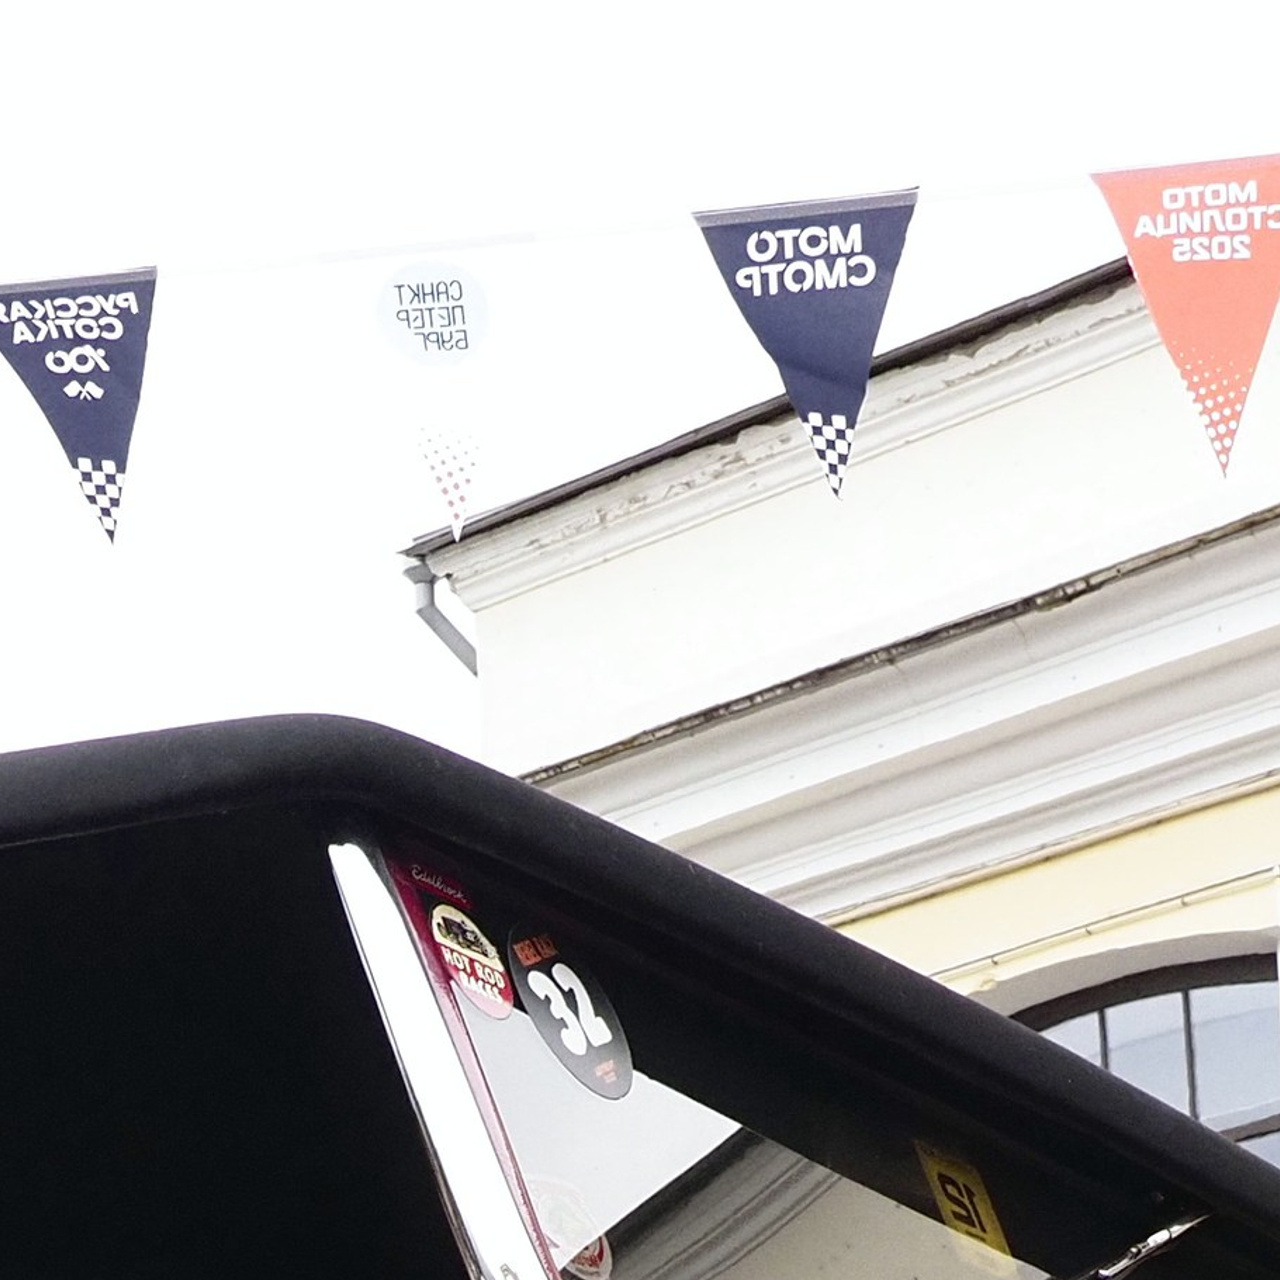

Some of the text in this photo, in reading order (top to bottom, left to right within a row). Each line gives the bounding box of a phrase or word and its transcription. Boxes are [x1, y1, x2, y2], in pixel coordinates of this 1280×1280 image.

[441, 945, 505, 989] HOT ROD
[527, 962, 613, 1056] 32
